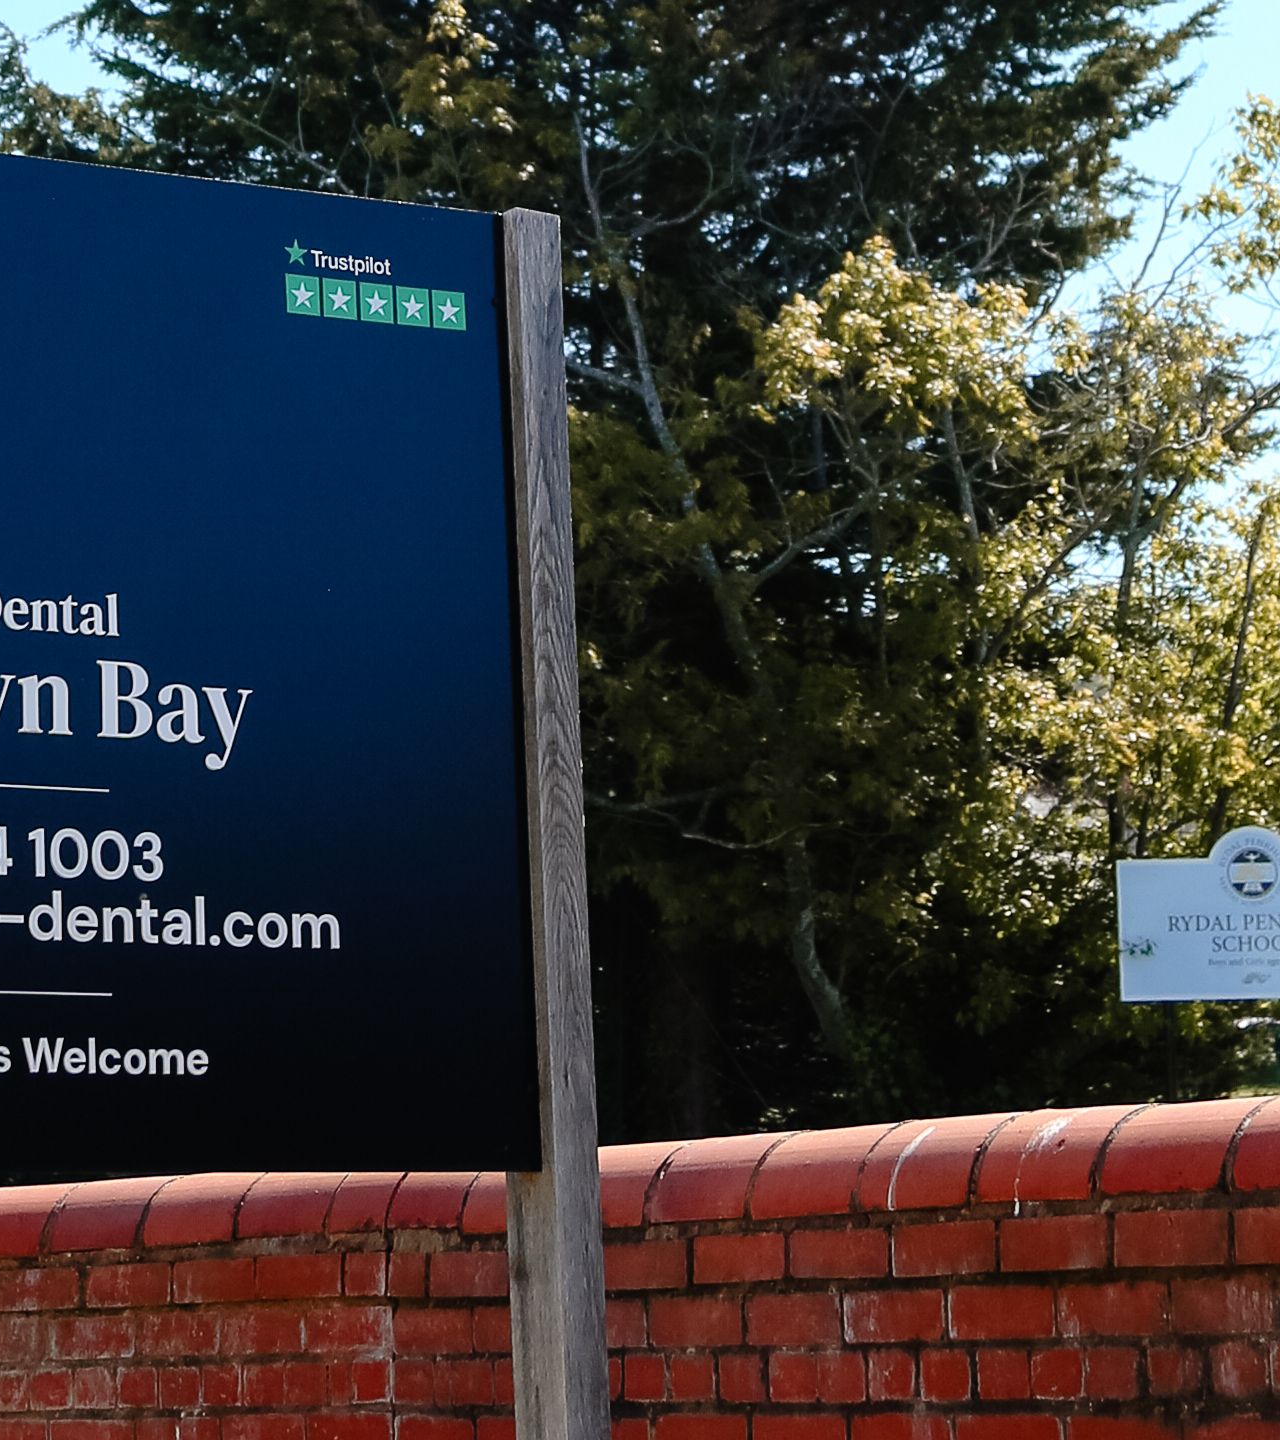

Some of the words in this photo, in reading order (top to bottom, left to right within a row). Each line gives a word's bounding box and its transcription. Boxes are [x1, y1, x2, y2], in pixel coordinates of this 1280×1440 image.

[310, 249, 392, 276] Trustpilot
[96, 659, 254, 771] Bay
[28, 827, 164, 882] 1003
[1167, 914, 1238, 932] RYDAL
[22, 1037, 209, 1076] Welcome
